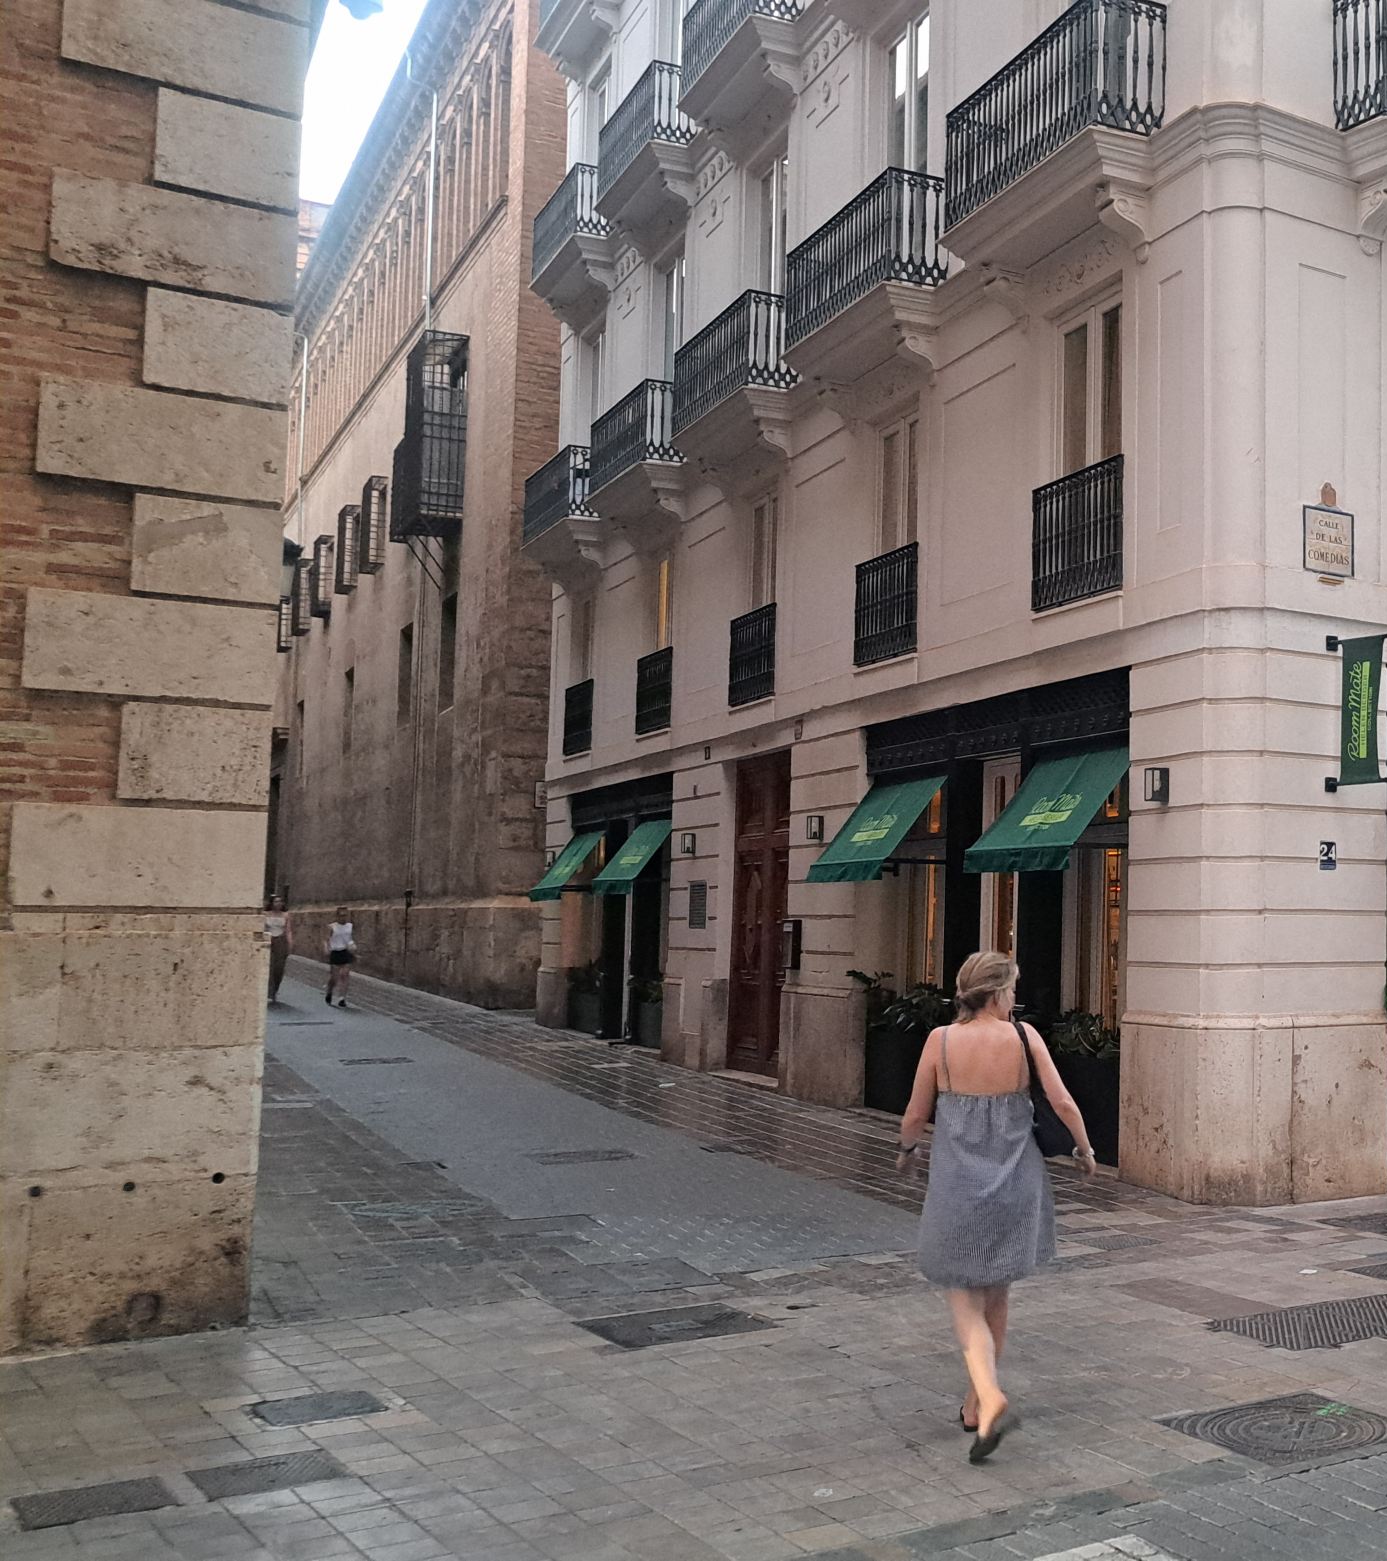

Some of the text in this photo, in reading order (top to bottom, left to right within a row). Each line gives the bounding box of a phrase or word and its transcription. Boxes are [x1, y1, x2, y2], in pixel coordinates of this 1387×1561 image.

[1318, 519, 1340, 530] CALLE
[1315, 532, 1343, 545] DE LAS
[1307, 549, 1350, 566] COMEDIAS
[1320, 844, 1336, 860] 24
